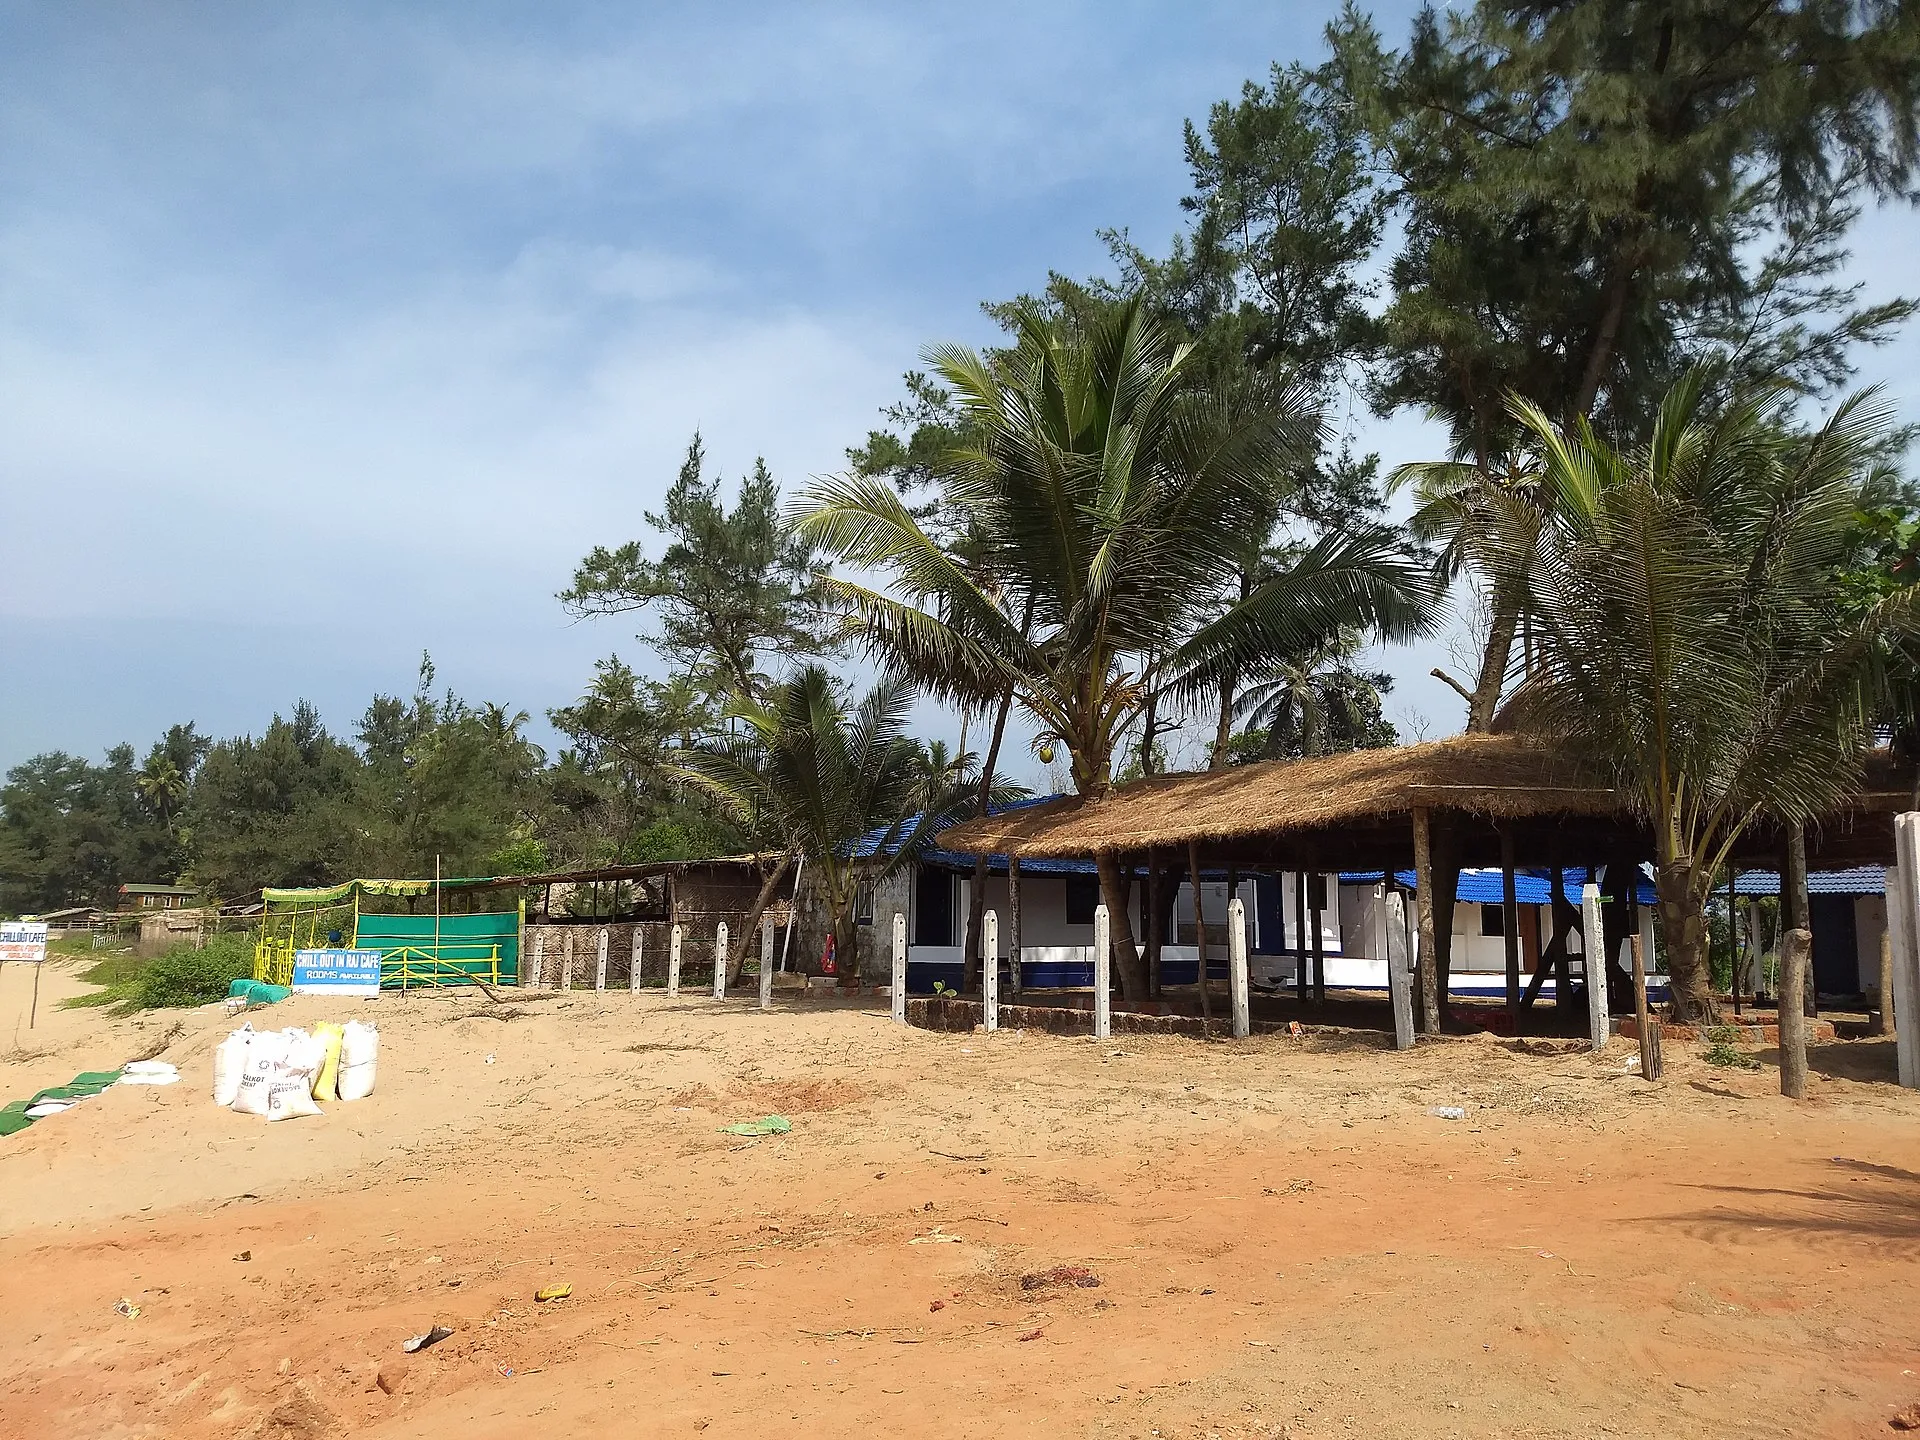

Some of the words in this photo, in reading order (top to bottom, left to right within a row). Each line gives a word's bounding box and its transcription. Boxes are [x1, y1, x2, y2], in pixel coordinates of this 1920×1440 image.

[29, 932, 47, 942] CAFE
[297, 953, 318, 968] CHILL
[320, 953, 336, 968] OUT
[336, 954, 345, 968] IN
[346, 954, 359, 968] RAJ
[361, 954, 379, 968] CAFE
[306, 970, 338, 979] ROOMS
